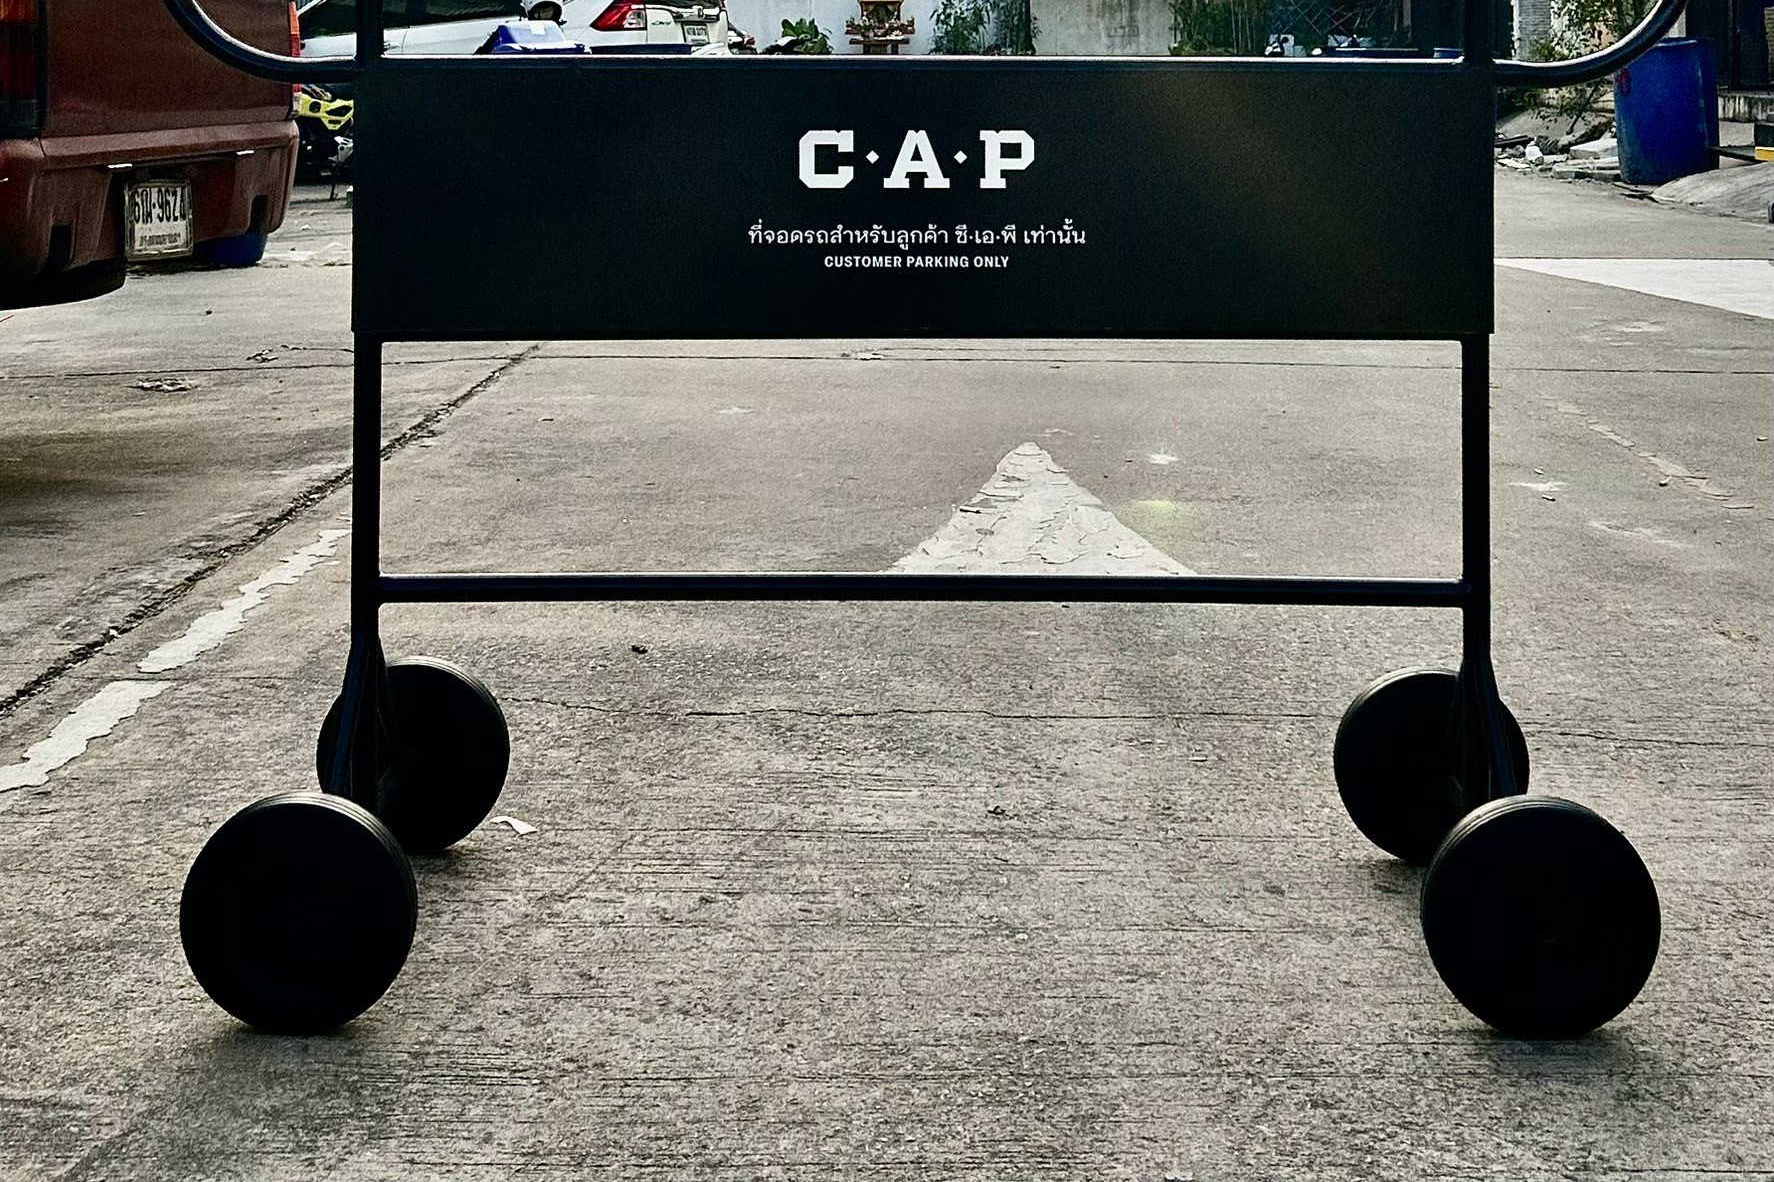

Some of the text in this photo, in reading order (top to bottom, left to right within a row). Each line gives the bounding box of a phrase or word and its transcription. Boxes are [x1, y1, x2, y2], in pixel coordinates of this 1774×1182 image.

[748, 218, 949, 250] ที่จอดรถสำหรับลูกค้า
[1024, 218, 1086, 245] เท่านั้น
[824, 256, 1010, 268] CUSTOMER PARKING ONLY
